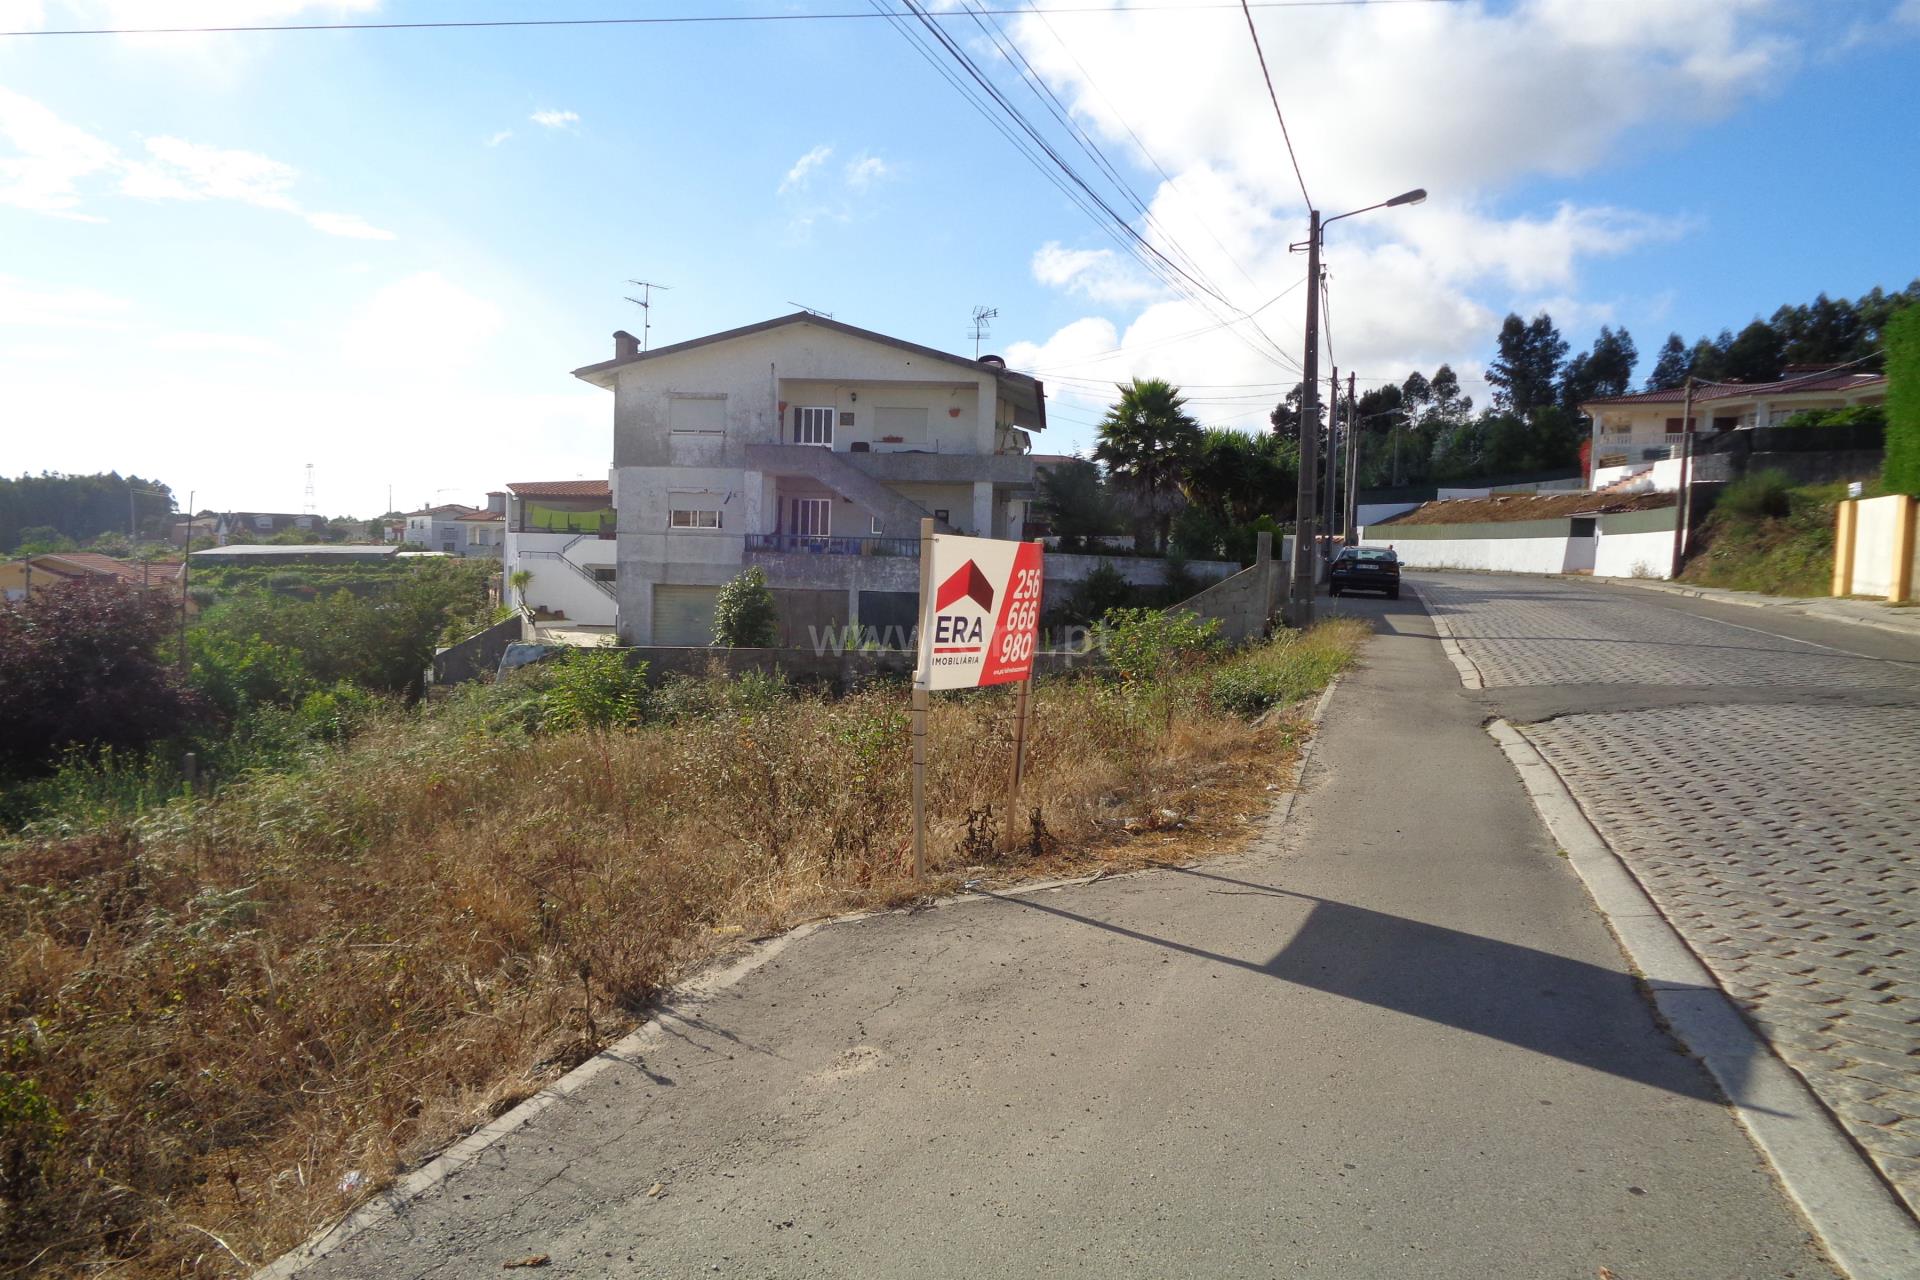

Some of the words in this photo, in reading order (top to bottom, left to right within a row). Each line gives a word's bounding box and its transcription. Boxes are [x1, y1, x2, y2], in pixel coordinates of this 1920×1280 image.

[1013, 569, 1041, 599] 256
[935, 616, 983, 643] ERA
[1007, 601, 1037, 631] 666
[1000, 633, 1032, 664] 980
